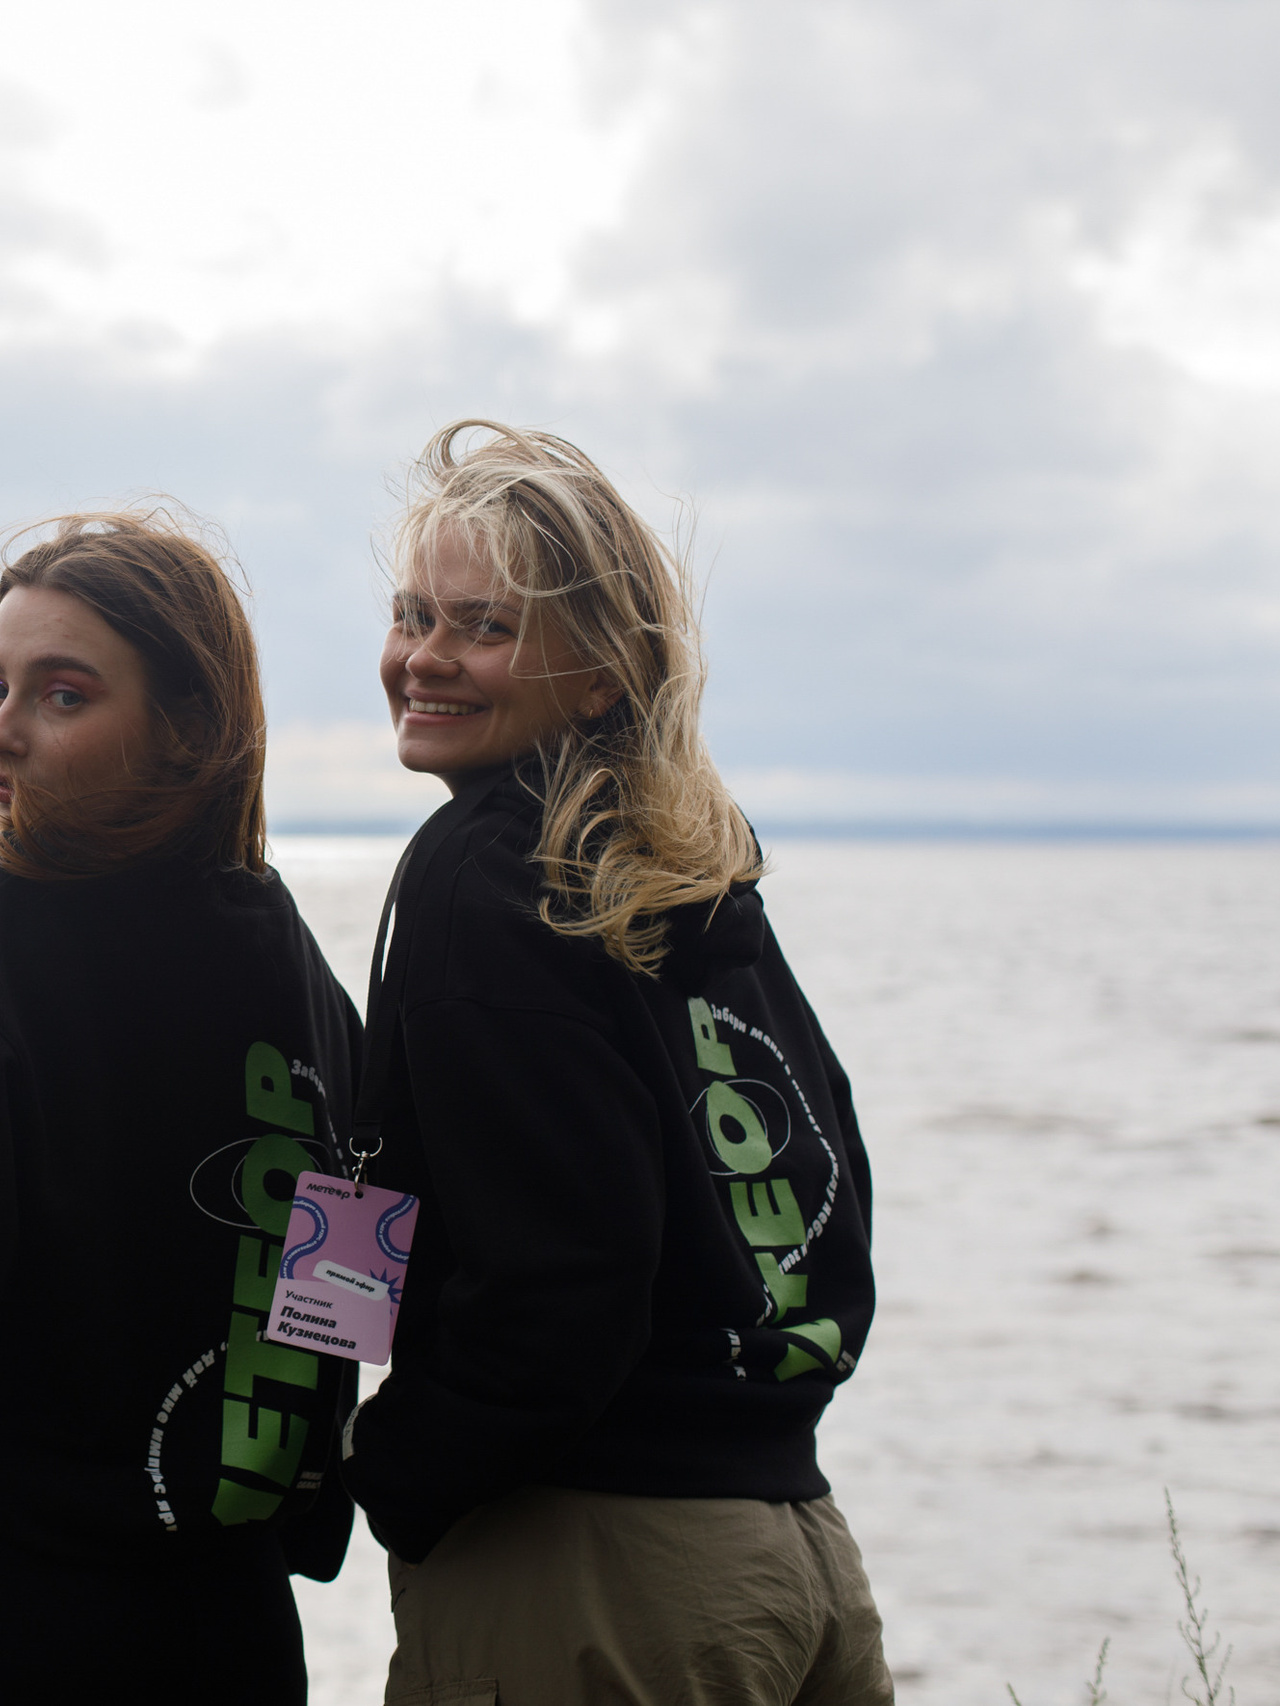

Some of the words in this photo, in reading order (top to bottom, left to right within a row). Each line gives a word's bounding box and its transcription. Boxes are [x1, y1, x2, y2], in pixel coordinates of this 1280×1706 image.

[711, 1003, 747, 1033] Забери
[749, 1026, 784, 1062] меня
[326, 1269, 356, 1284] прямой
[355, 1281, 376, 1293] эфир
[285, 1290, 333, 1309] Участник
[280, 1305, 338, 1328] Полина
[277, 1321, 357, 1350] Кузнецова
[182, 1349, 216, 1388] дай
[156, 1382, 184, 1425] мне
